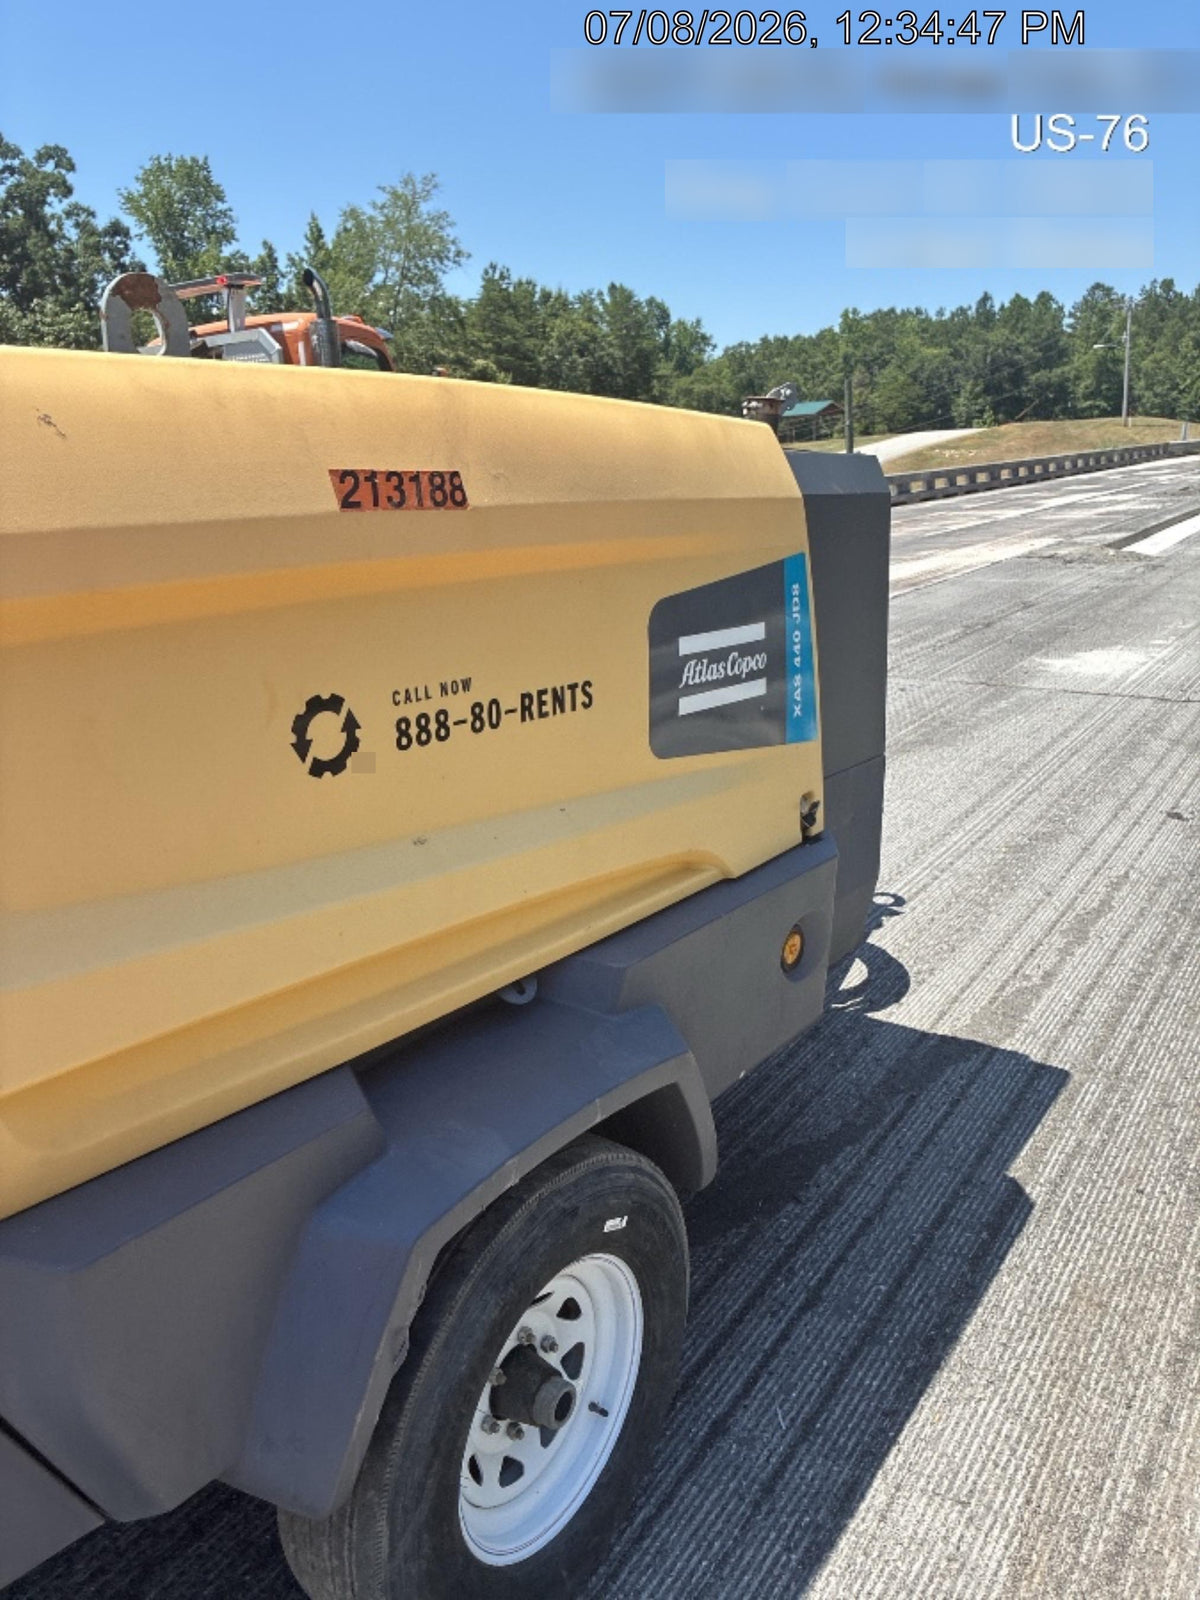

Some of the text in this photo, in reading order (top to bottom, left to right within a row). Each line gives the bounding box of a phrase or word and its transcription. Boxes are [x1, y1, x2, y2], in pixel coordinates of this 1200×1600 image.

[339, 469, 468, 509] 213188
[792, 630, 802, 668] 440
[679, 651, 768, 689] Atlas Copco
[392, 676, 473, 706] CALL NOW
[395, 679, 594, 752] 888-80-RENTS
